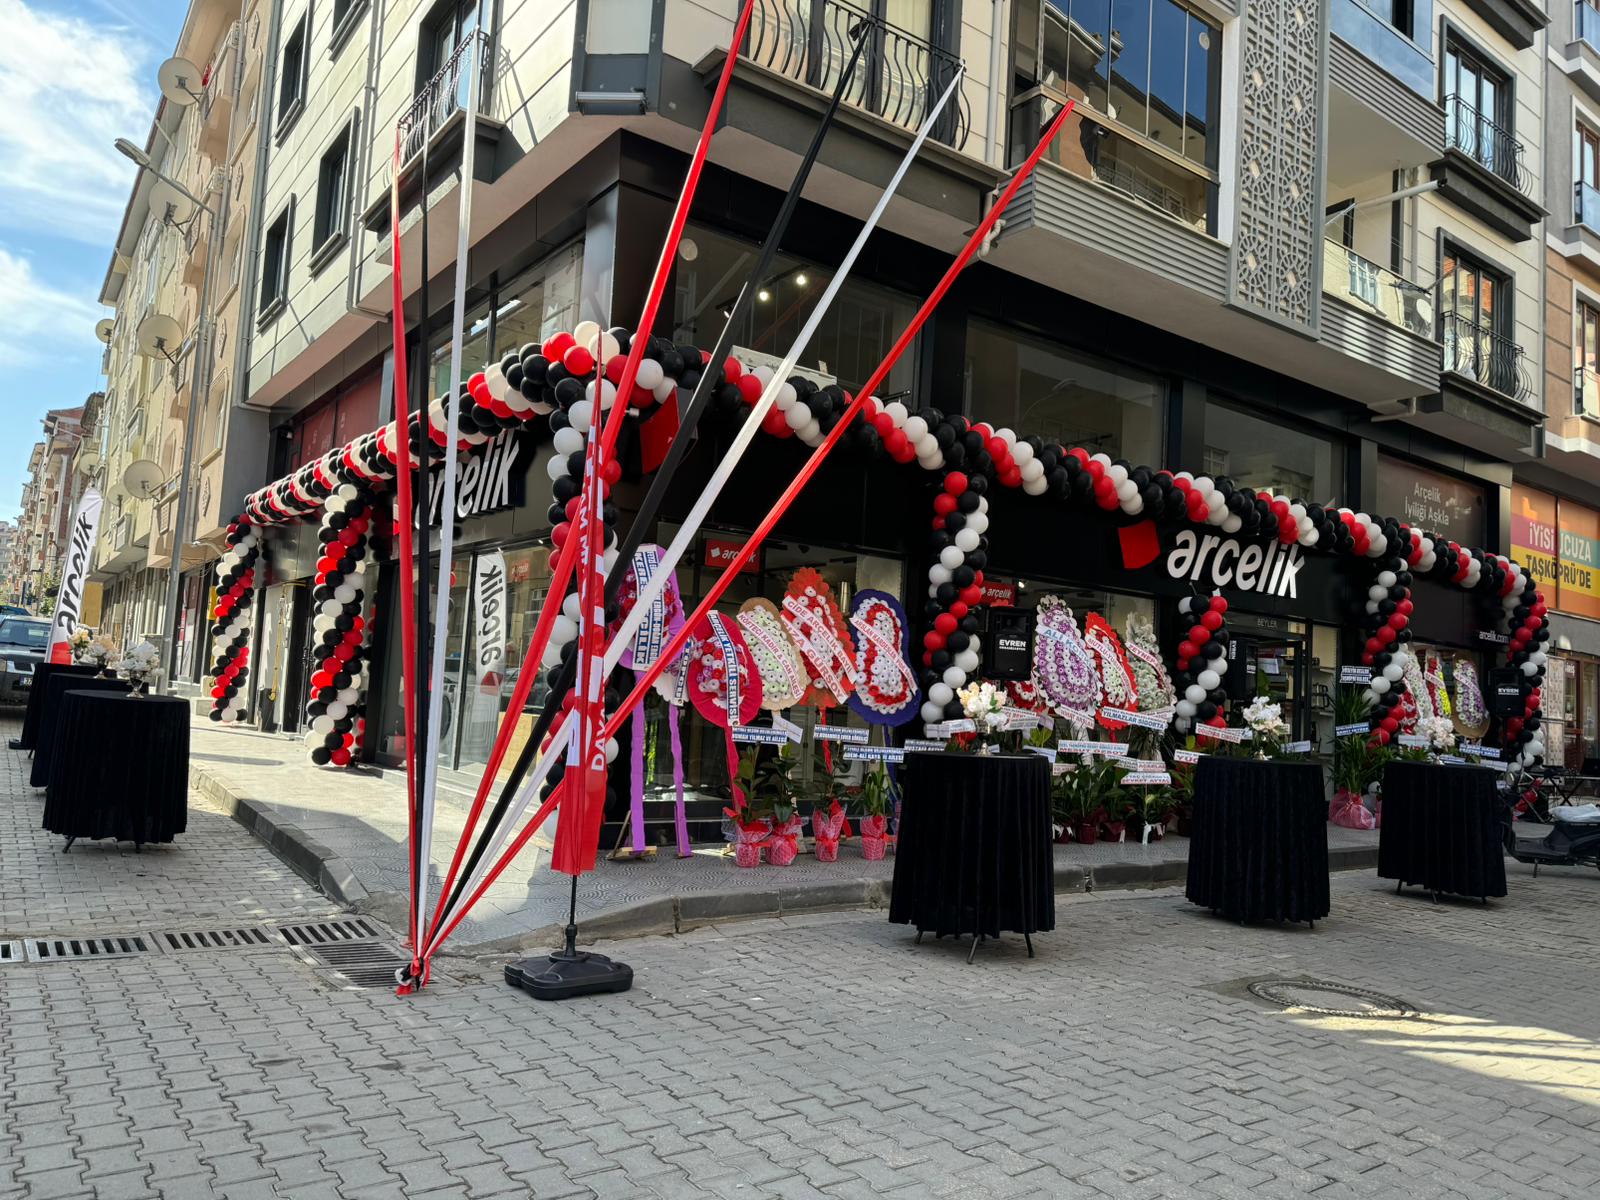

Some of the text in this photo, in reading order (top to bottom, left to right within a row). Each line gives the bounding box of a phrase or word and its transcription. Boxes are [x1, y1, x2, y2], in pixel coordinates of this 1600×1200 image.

[1414, 482, 1441, 503] Arçelik
[1404, 497, 1450, 526] İyiliği Aşkla
[999, 639, 1027, 648] EVREN
